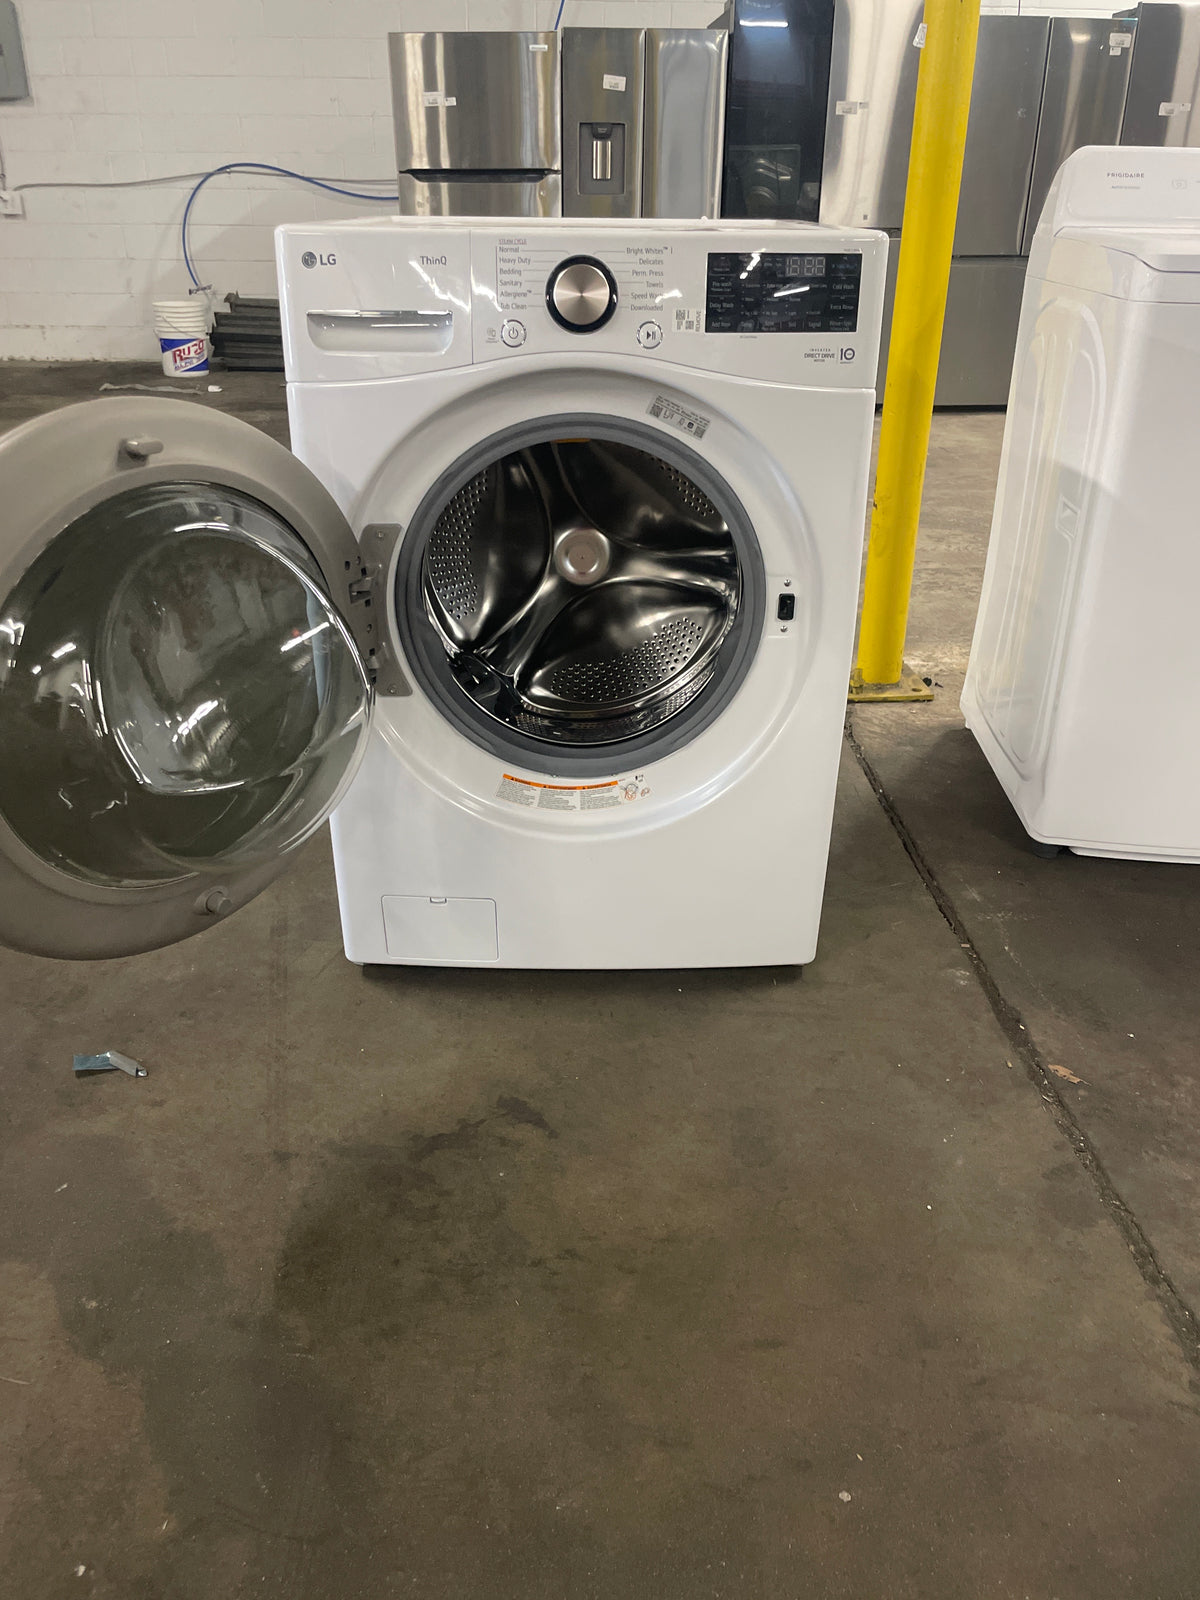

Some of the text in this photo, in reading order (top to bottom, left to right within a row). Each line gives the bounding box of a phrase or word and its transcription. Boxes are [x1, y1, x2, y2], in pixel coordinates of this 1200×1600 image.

[626, 247, 643, 255] Bright
[319, 253, 337, 266] LG
[419, 255, 447, 265] ThinQ
[499, 257, 531, 265] Heavy Duty
[499, 268, 522, 276] Bedding
[499, 280, 523, 288] Sanitary
[630, 292, 647, 300] Speed
